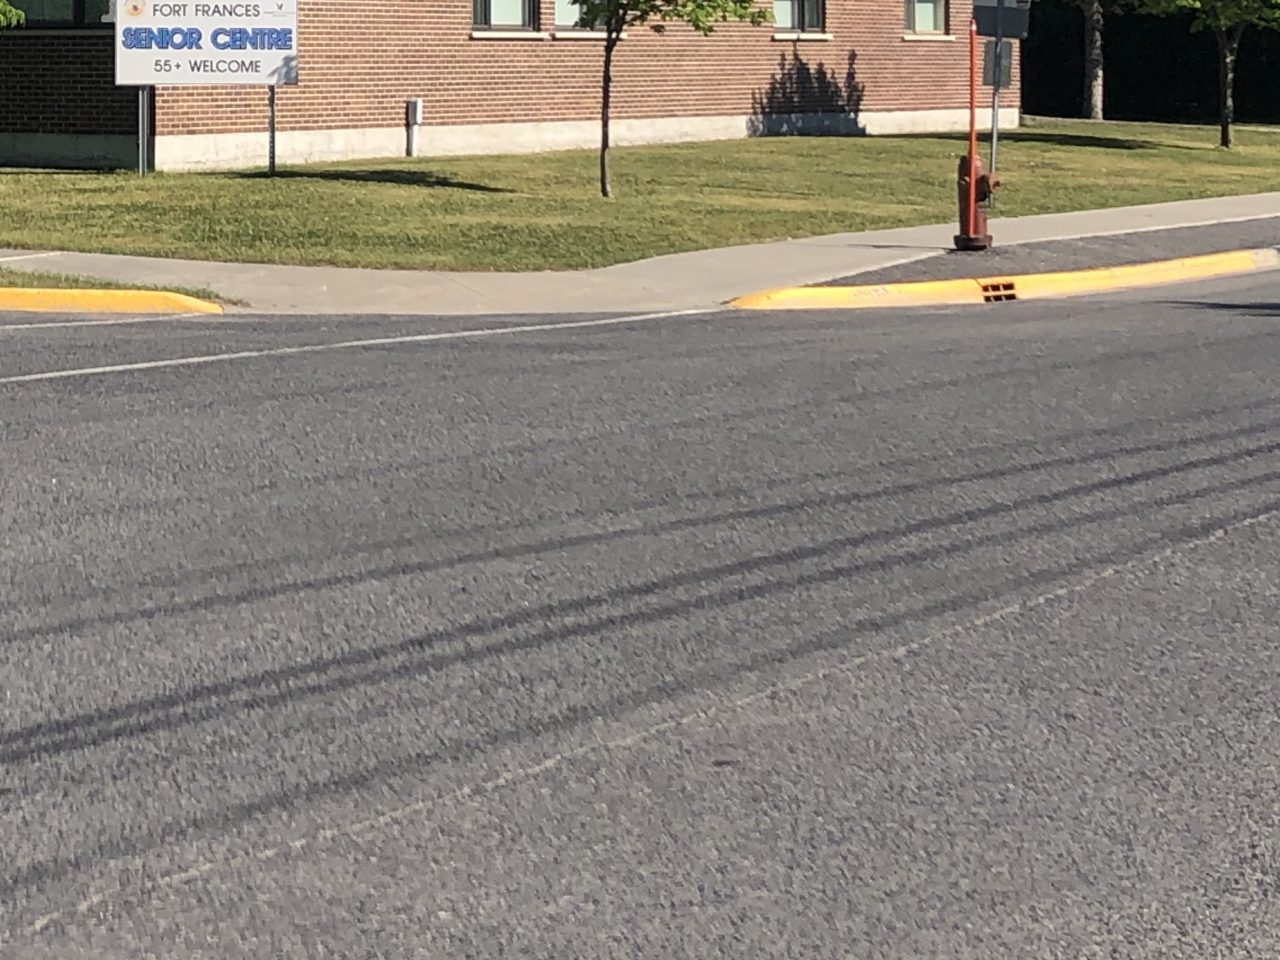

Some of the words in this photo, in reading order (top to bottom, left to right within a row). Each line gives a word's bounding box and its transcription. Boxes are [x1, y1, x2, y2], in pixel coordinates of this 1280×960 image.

[152, 3, 188, 17] FORT
[194, 3, 260, 17] FRANCES
[121, 26, 203, 50] SENIOR
[210, 27, 293, 50] CENTRE
[153, 59, 181, 73] 55+
[188, 59, 261, 73] WELCOME
